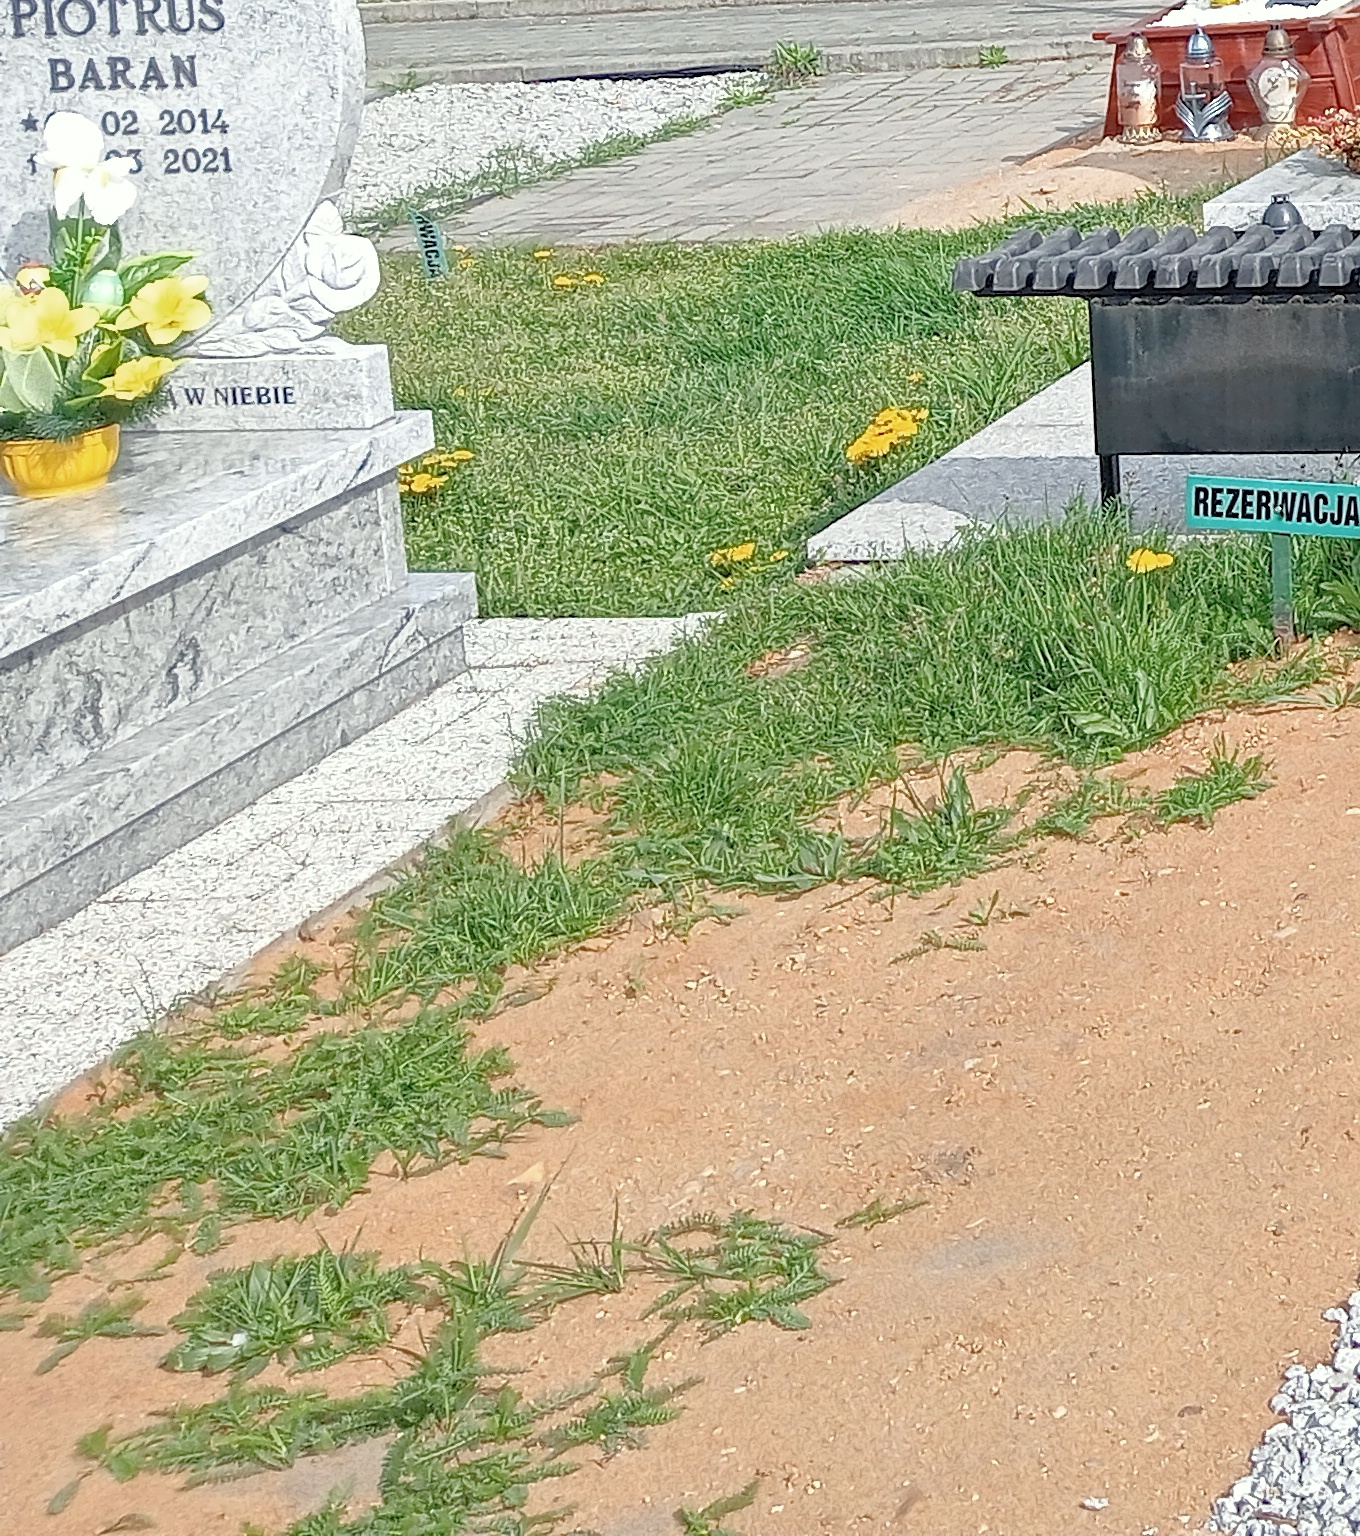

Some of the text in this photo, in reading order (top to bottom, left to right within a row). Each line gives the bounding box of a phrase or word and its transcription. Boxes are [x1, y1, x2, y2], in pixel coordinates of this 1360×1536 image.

[47, 52, 198, 93] BARAN
[100, 109, 139, 137] 02
[158, 108, 230, 136] 2014
[163, 146, 233, 175] 2021
[183, 387, 206, 406] W
[214, 386, 298, 406] NIEBIE
[1194, 486, 1360, 526] REZERWACJA
